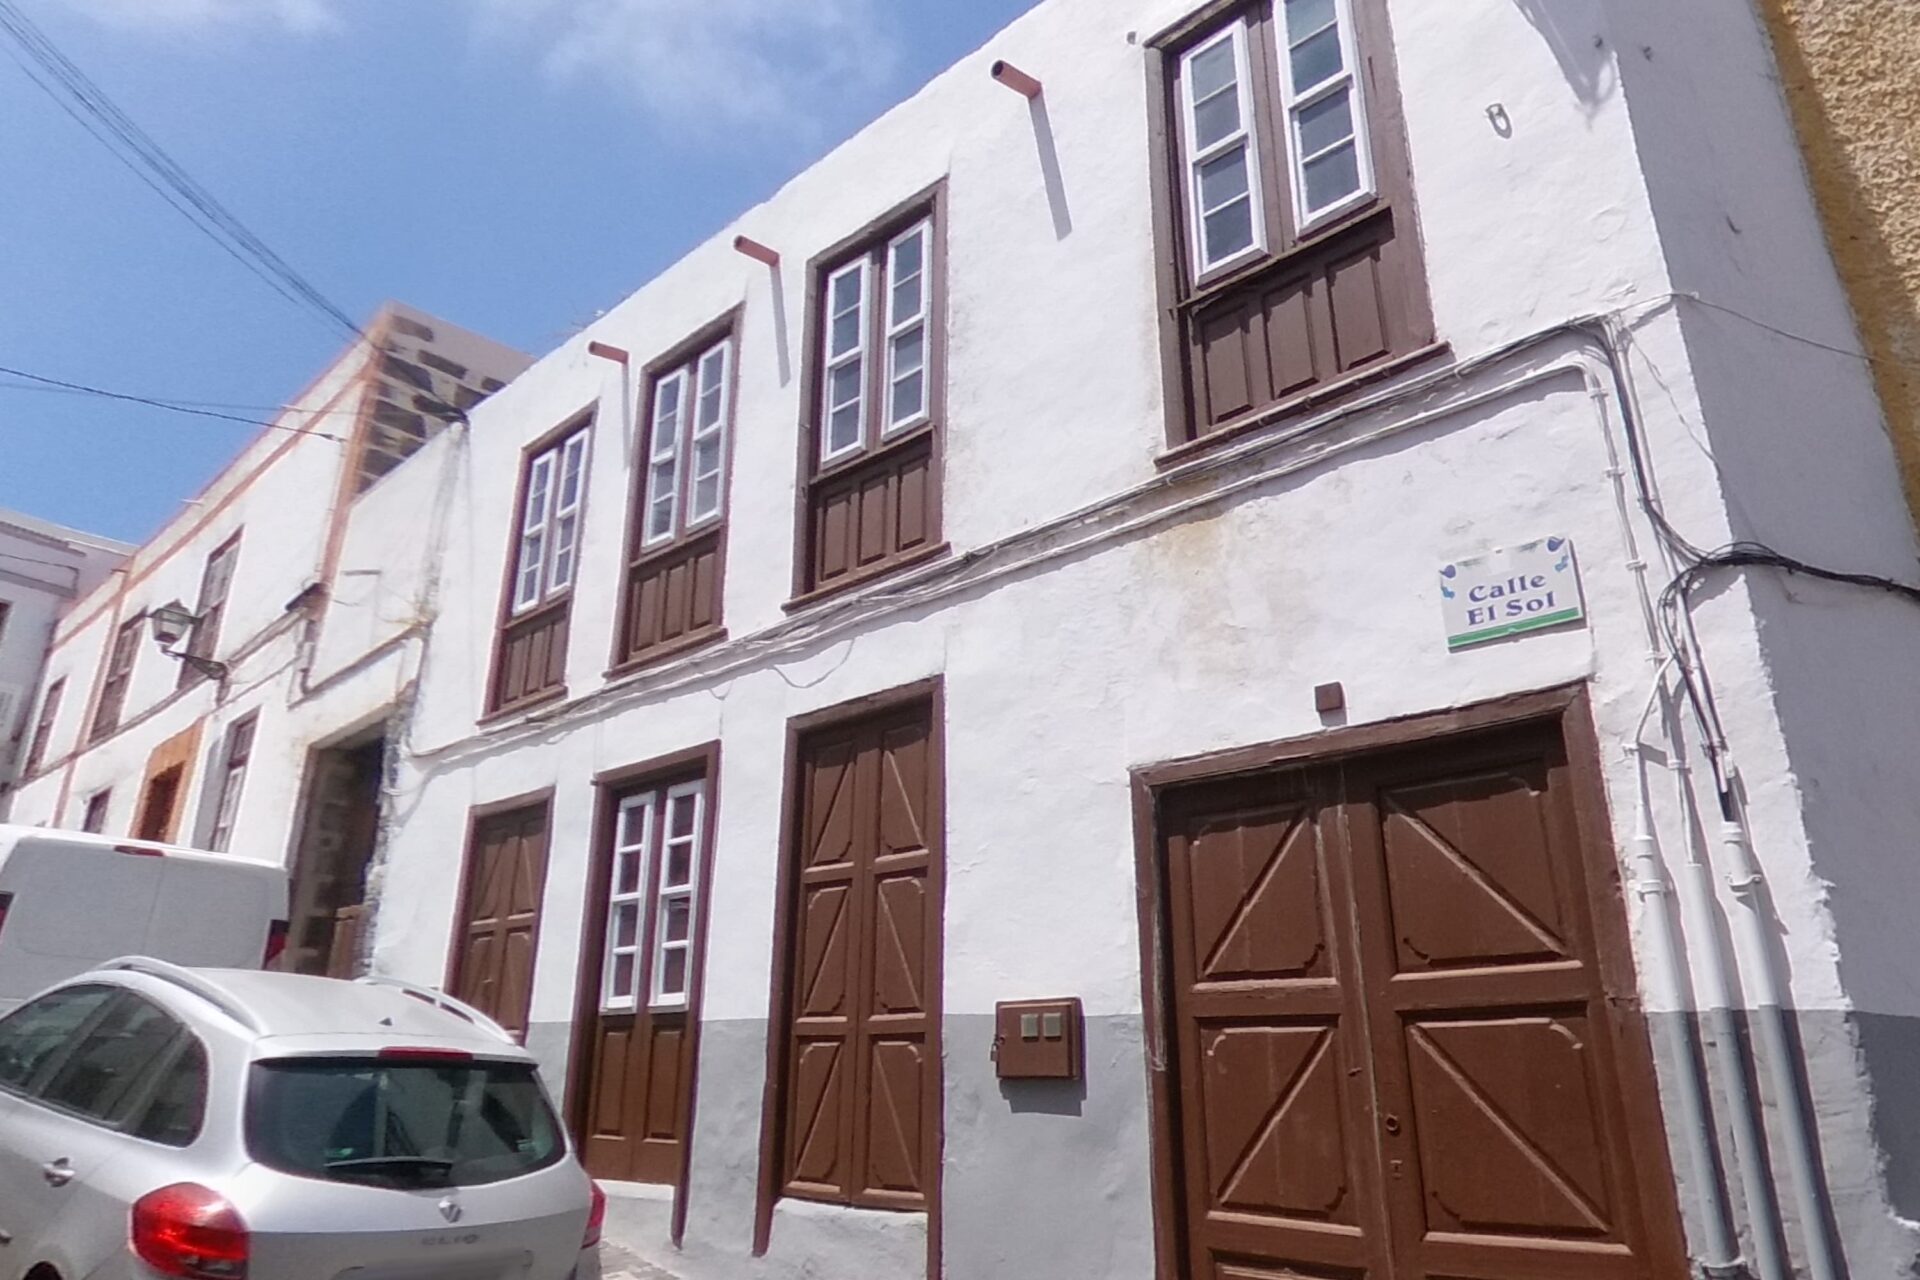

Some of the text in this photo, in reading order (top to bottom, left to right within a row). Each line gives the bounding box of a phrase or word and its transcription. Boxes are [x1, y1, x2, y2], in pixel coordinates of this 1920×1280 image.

[1469, 575, 1546, 602] Calle
[1467, 591, 1555, 626] El Sol
